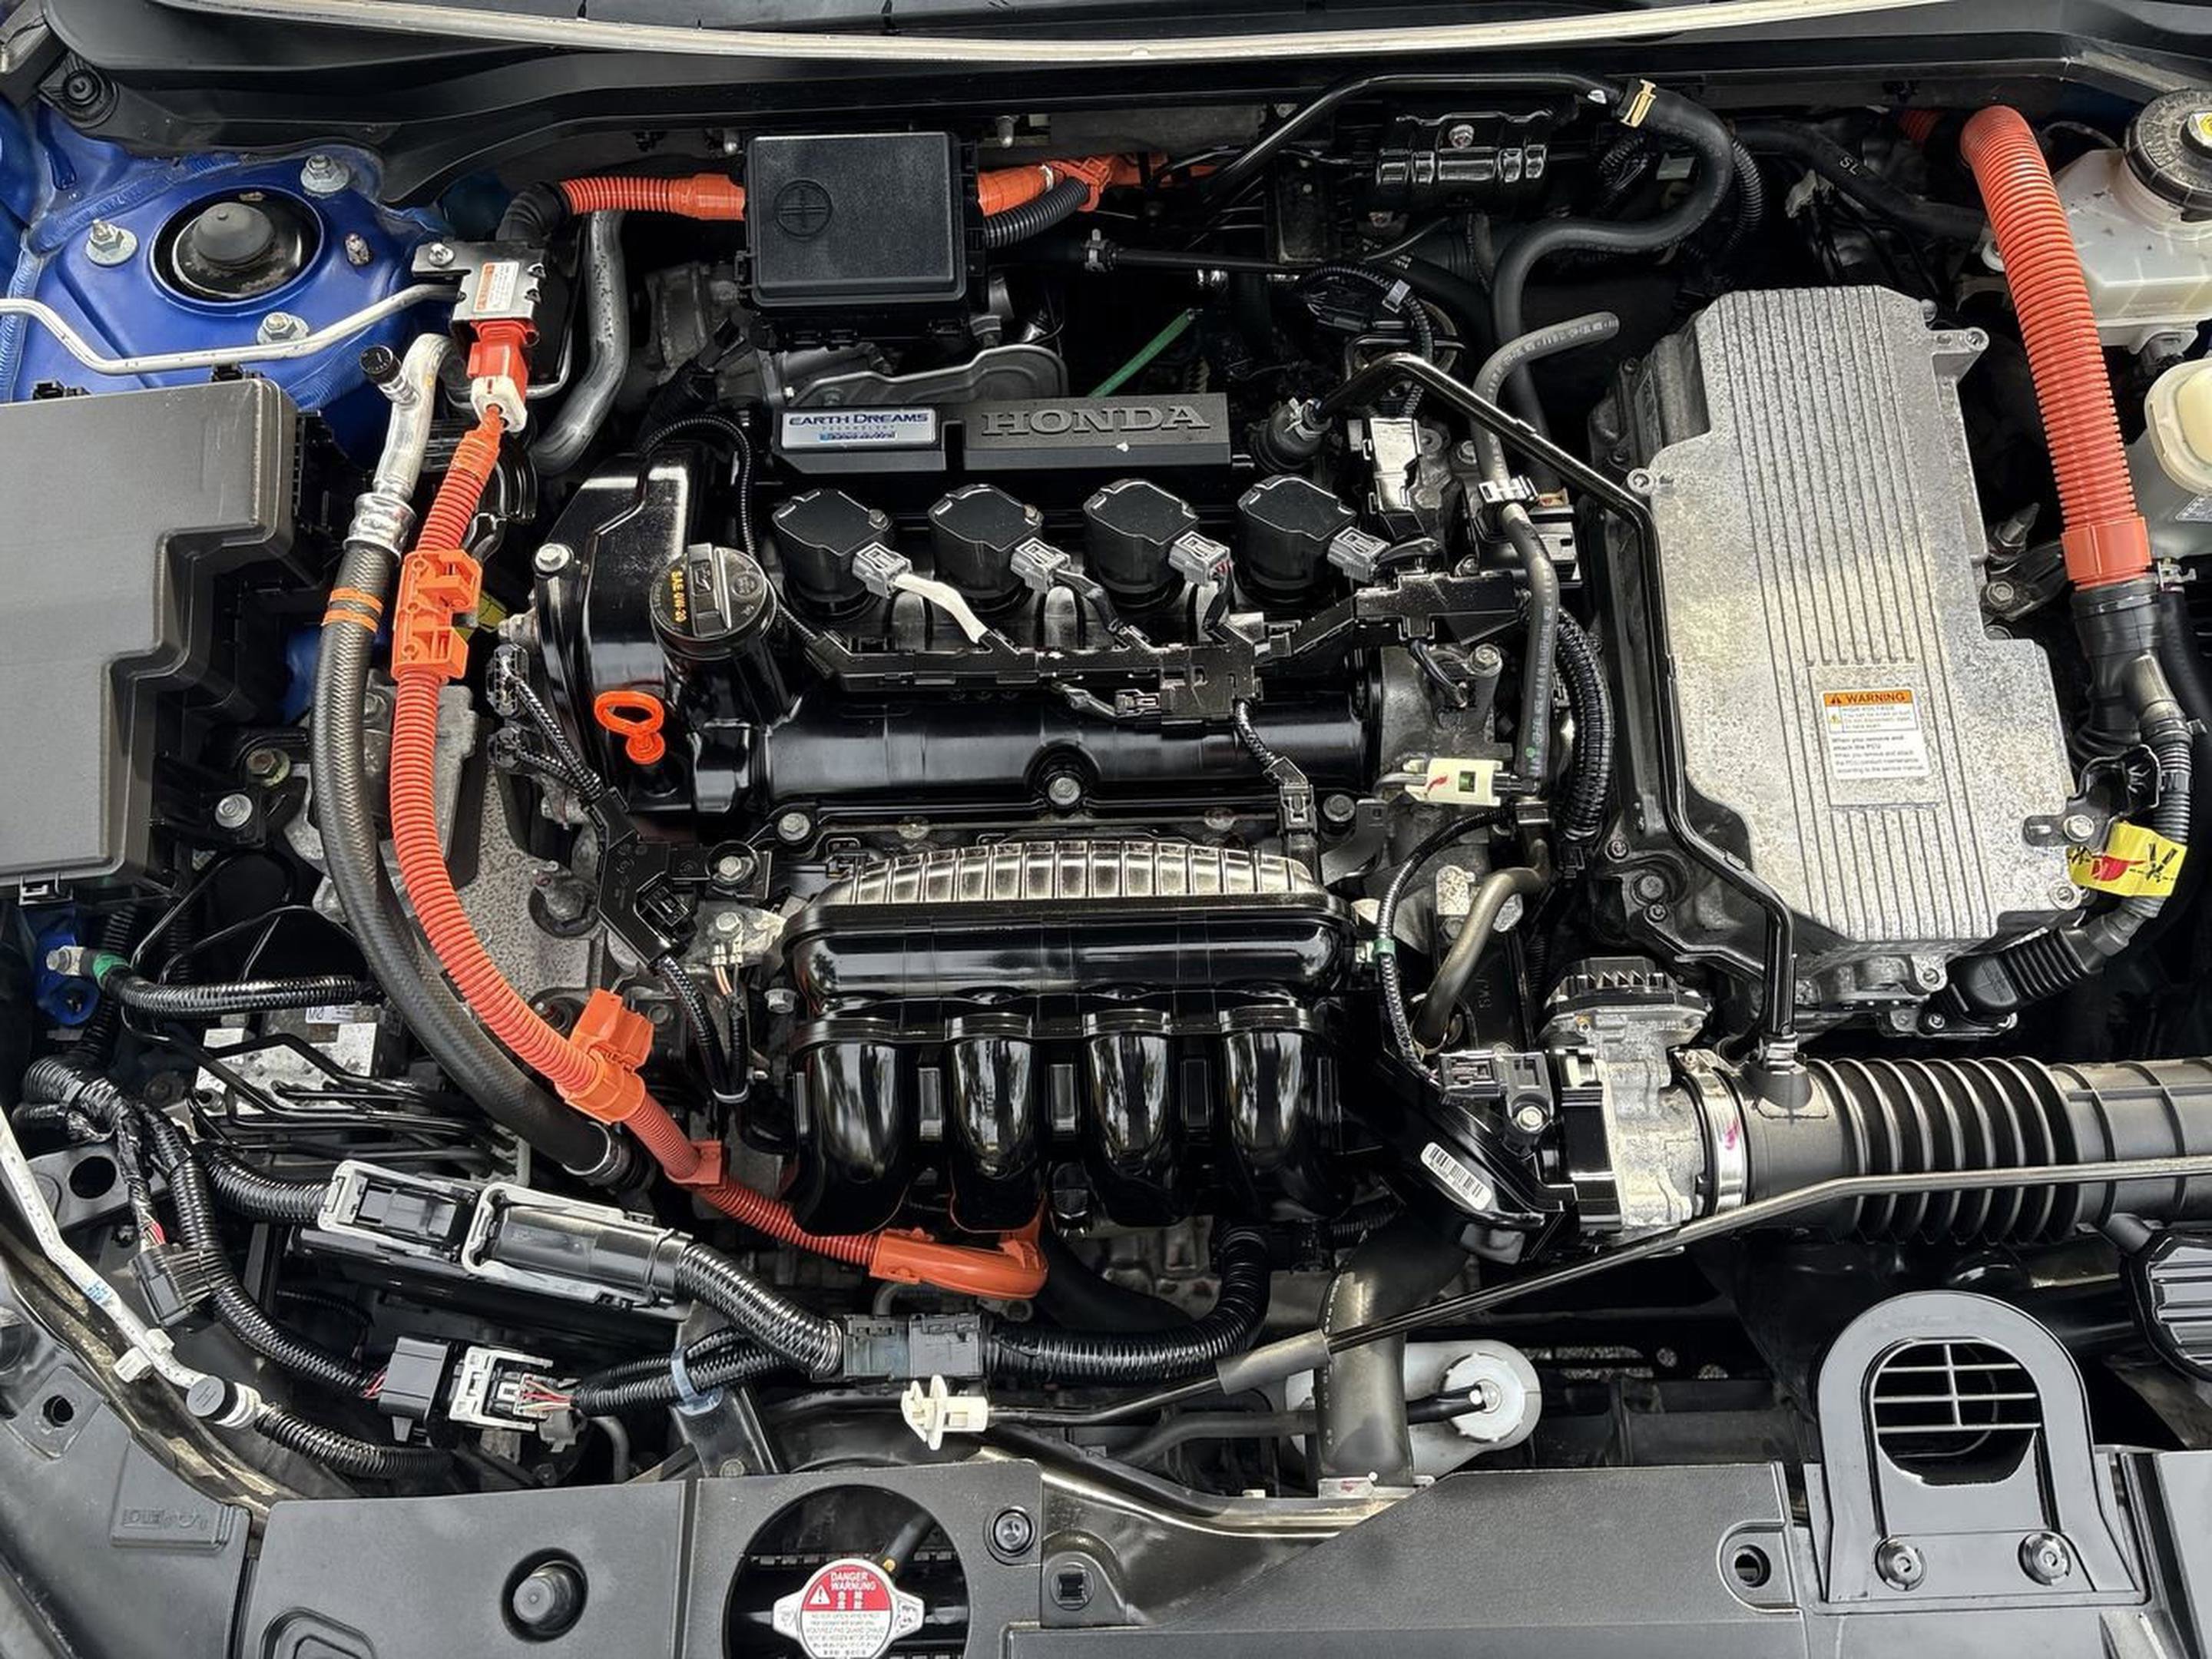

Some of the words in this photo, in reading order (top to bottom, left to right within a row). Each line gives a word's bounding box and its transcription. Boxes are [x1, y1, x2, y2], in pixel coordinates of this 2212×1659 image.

[1839, 157, 1859, 175] SL
[790, 415, 849, 426] EARTH
[853, 412, 929, 424] DREAMS
[982, 405, 1210, 435] HONDA
[671, 570, 684, 591] SAE
[1846, 692, 1905, 704] WARNING
[830, 1572, 869, 1581] DANGER
[830, 1581, 876, 1591] WARNING
